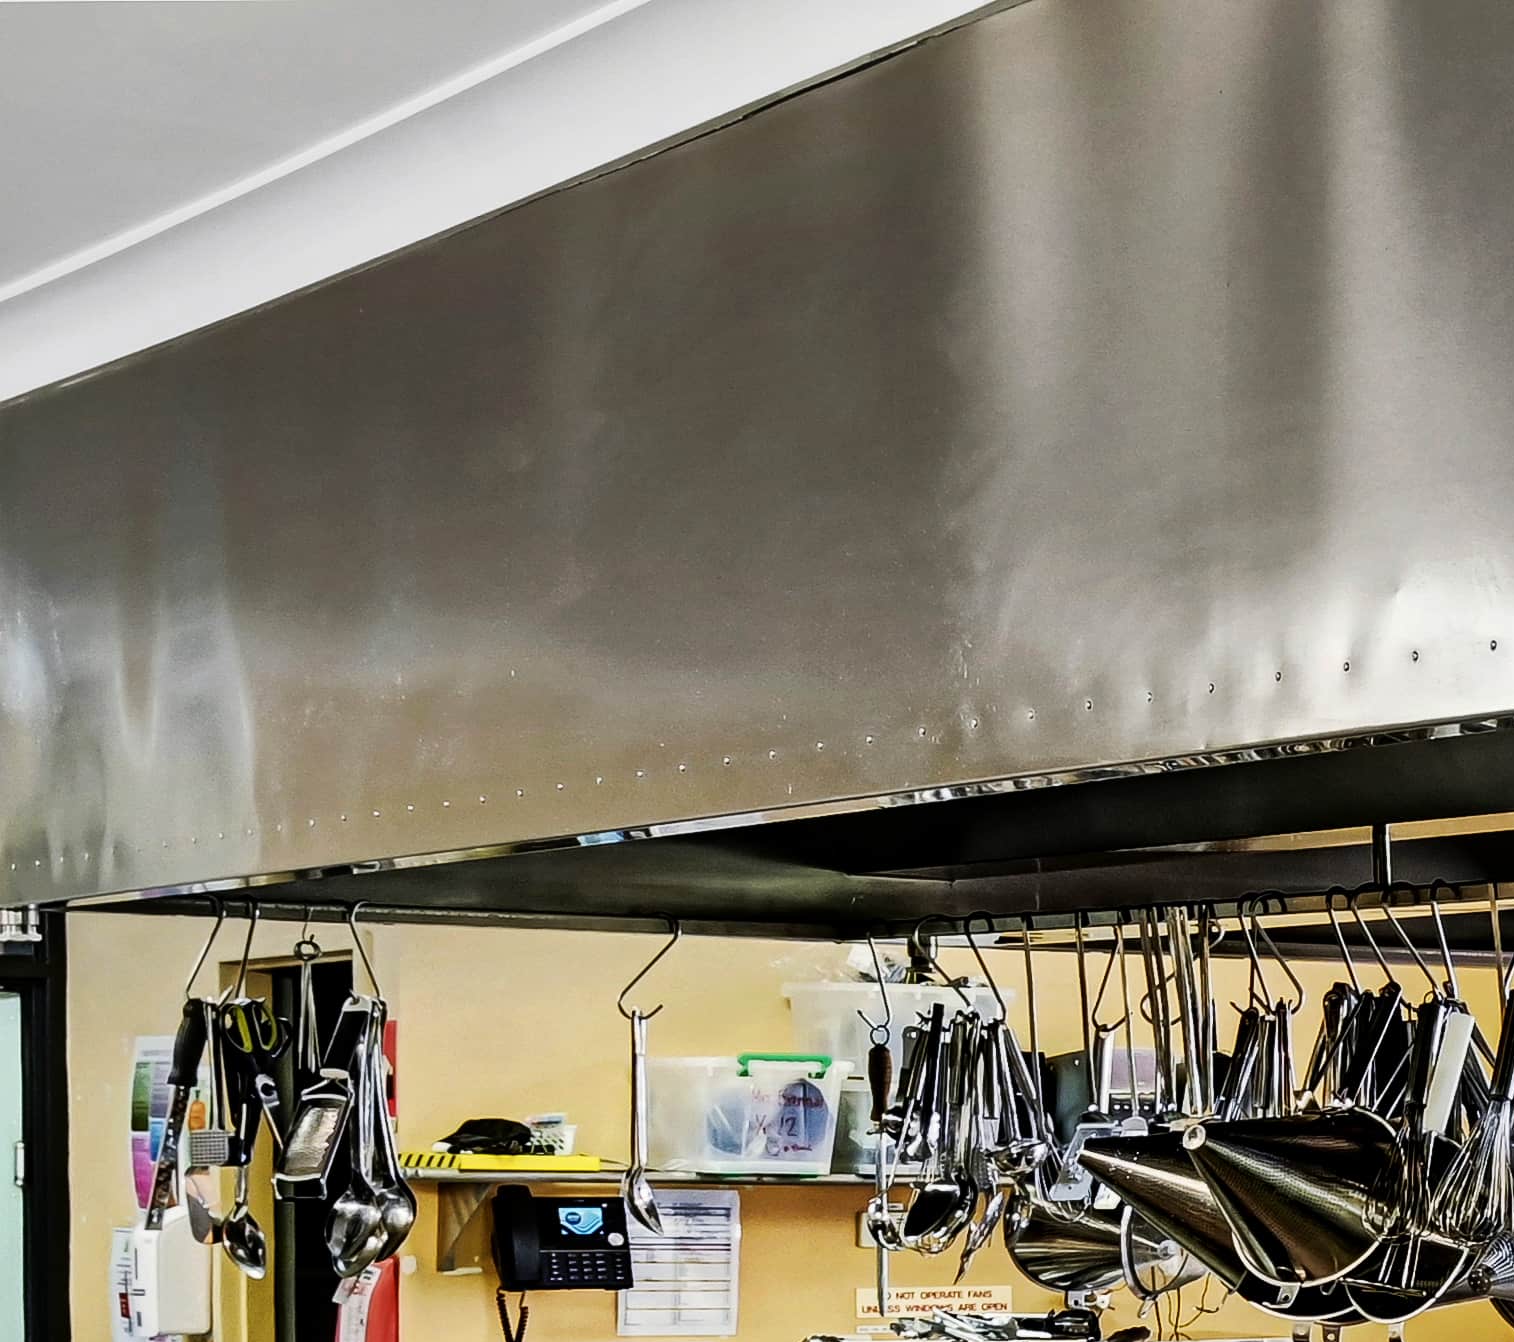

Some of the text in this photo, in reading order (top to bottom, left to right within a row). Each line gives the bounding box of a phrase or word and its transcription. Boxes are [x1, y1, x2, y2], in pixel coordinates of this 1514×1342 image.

[896, 1292, 915, 1300] NOT
[921, 1290, 963, 1299] OPERATE
[968, 1290, 992, 1299] FANS
[959, 1303, 976, 1311] ARE
[982, 1302, 1008, 1311] OPEN
